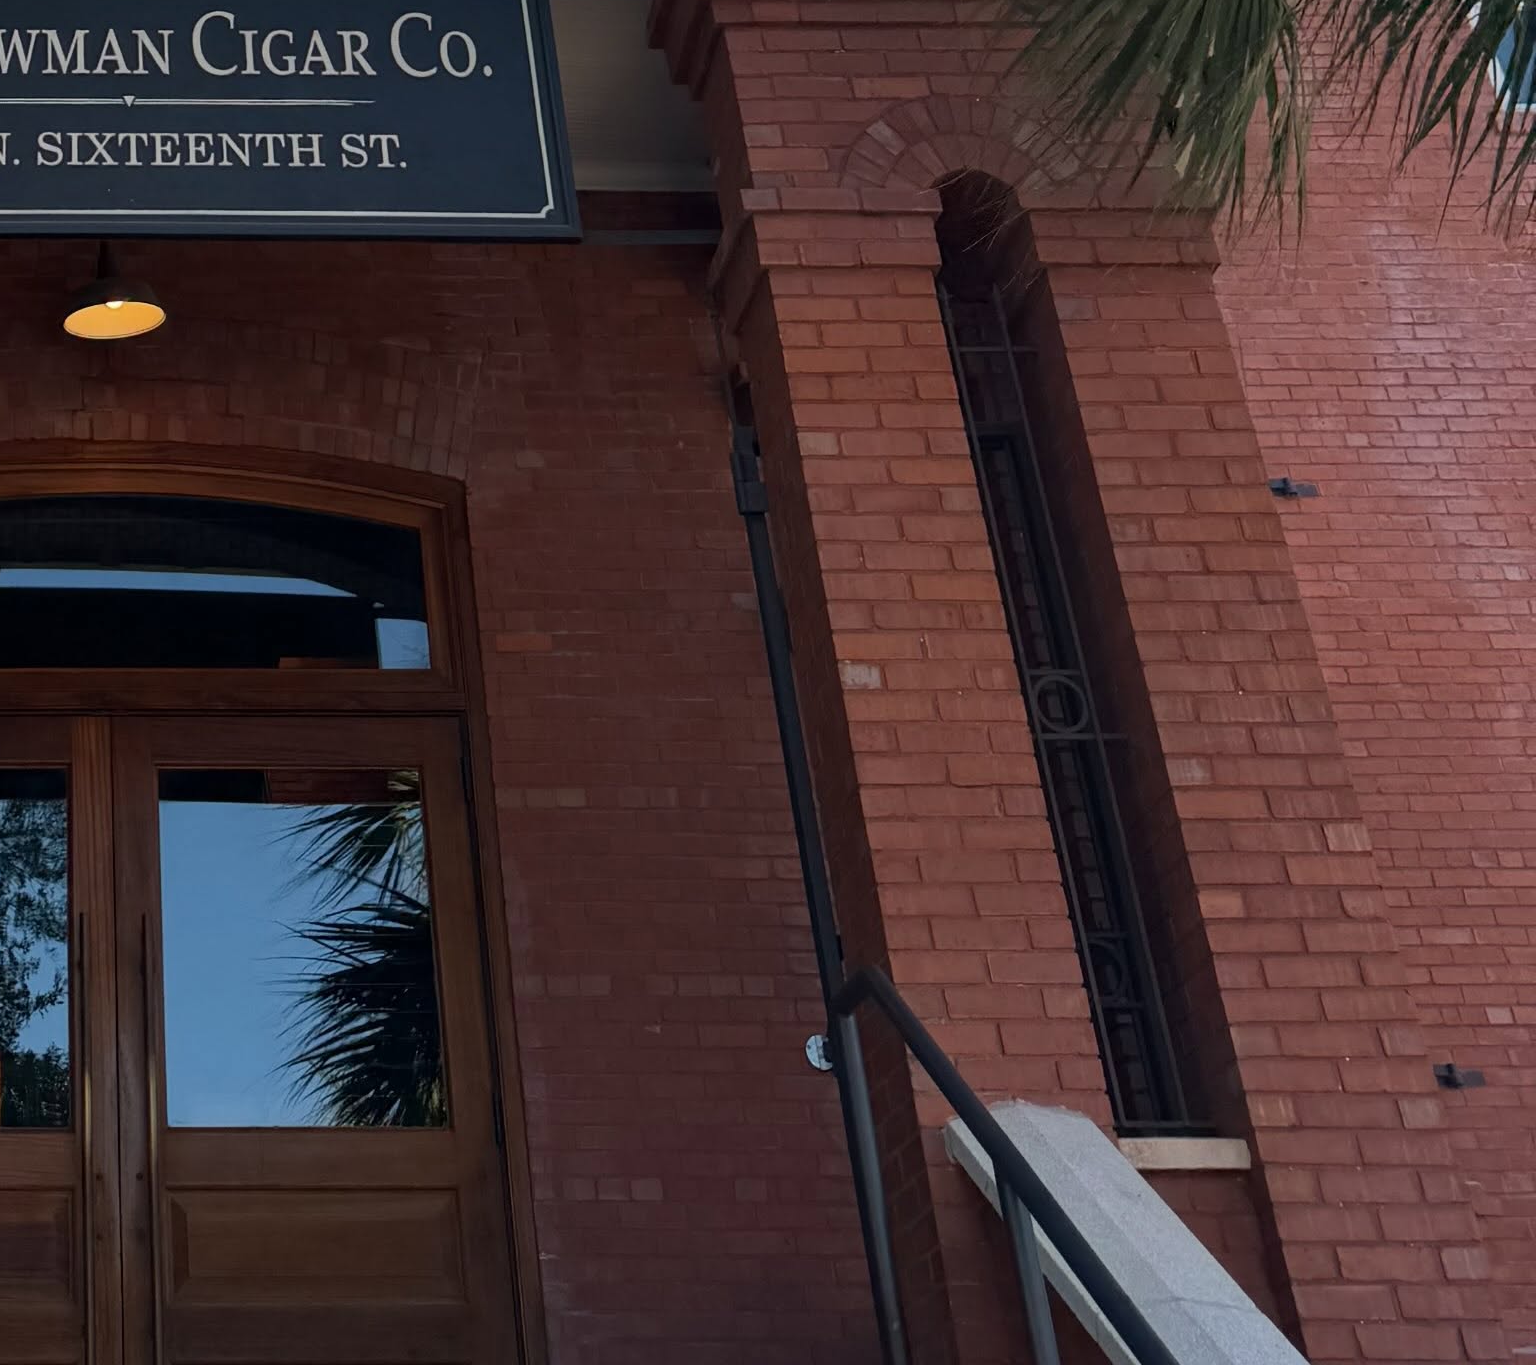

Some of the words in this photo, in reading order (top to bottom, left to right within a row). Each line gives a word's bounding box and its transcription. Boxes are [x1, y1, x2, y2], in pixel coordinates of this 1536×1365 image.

[192, 10, 378, 77] CIGAR
[37, 131, 326, 168] SIXTEENTH
[340, 132, 408, 169] ST.
